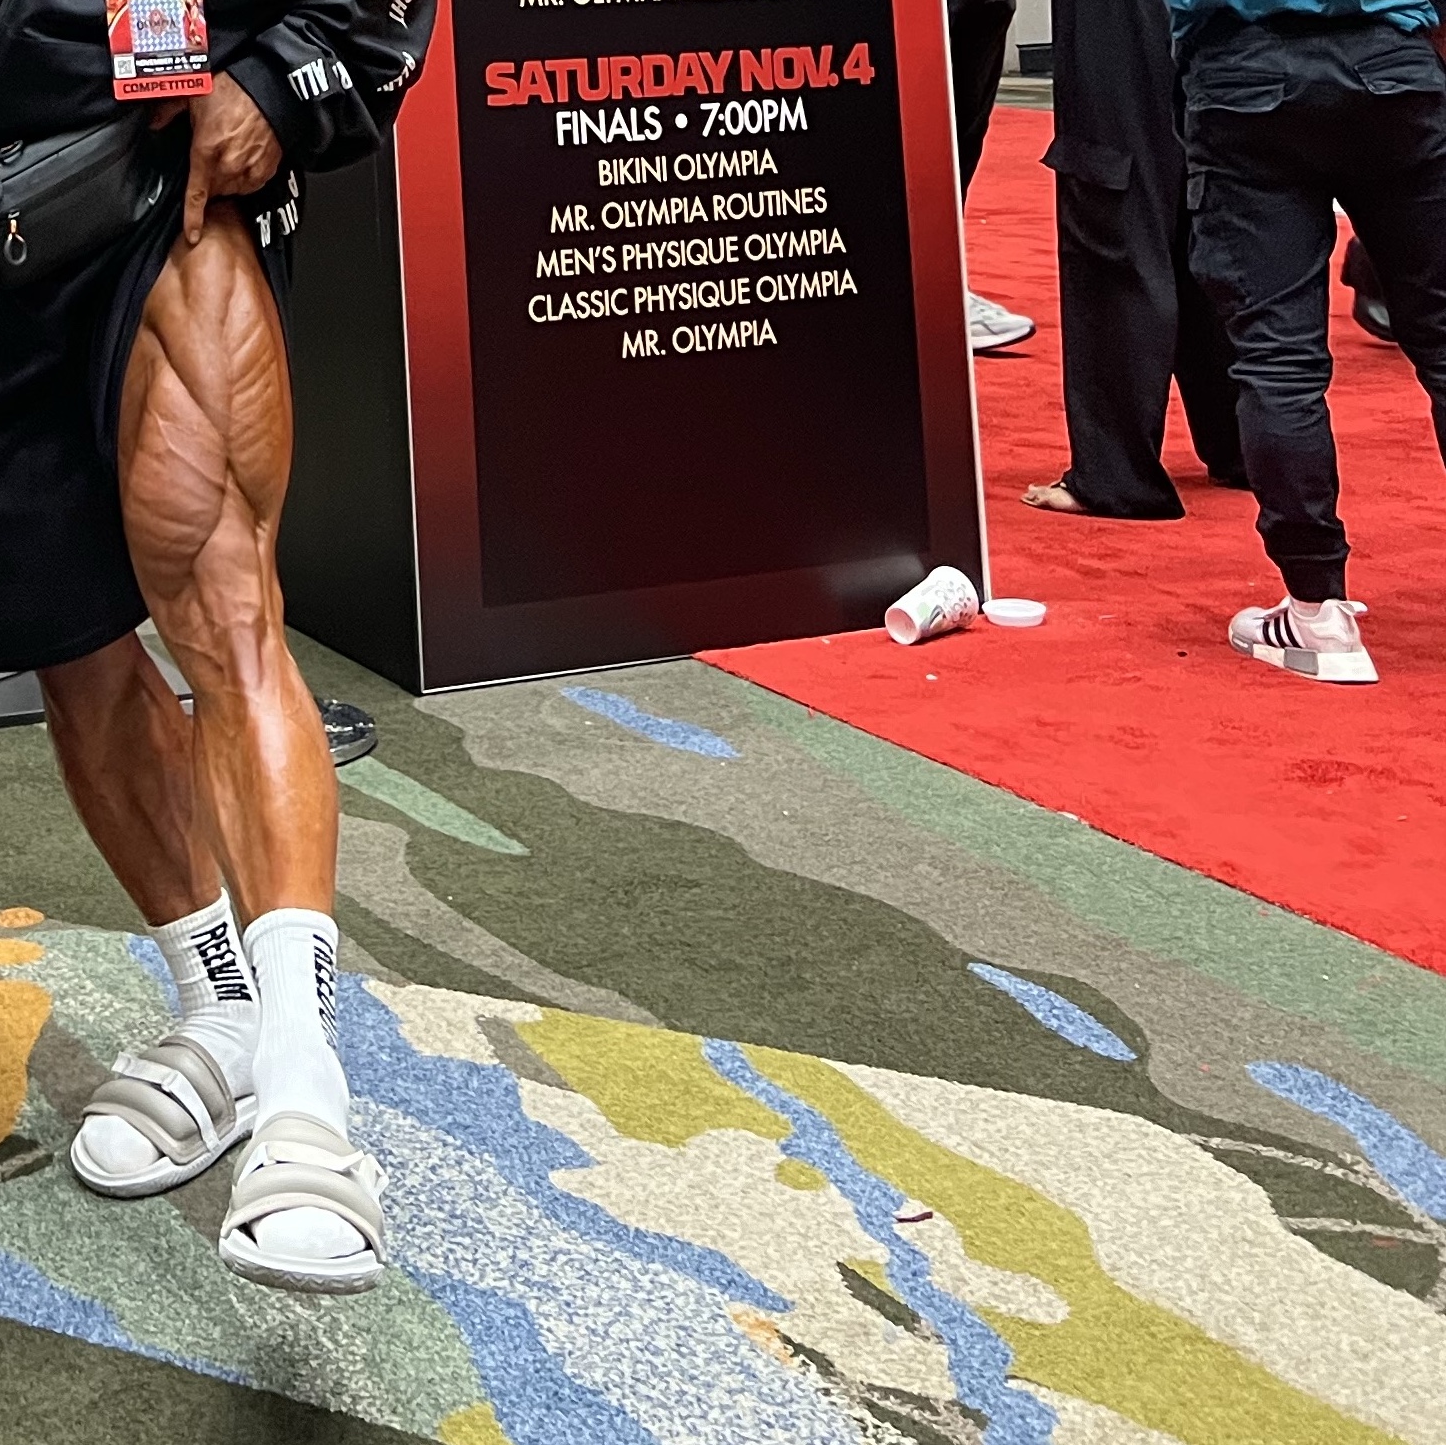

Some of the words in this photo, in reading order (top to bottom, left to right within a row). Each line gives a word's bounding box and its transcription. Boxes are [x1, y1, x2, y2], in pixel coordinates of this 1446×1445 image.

[123, 77, 204, 94] COMPETITOR
[485, 50, 734, 107] SATURDAY
[740, 45, 838, 92] NOV.
[843, 42, 875, 85] 4
[556, 106, 662, 145] FINALS
[699, 93, 807, 137] 7:00PM
[599, 156, 667, 186] BIKINI
[674, 148, 778, 181] OLYMPIA
[551, 205, 595, 233] MR.
[602, 196, 708, 229] OLYMPIA
[713, 187, 827, 221] ROUTINES
[537, 246, 616, 278] MEN'S
[623, 236, 739, 271] PHYSIQUE
[745, 228, 846, 260] OLYMPIA
[529, 288, 628, 322] CLASSIC
[634, 278, 750, 313] PHYSIQUE
[756, 269, 857, 302] OLYMPIA
[622, 330, 666, 358] MR.
[672, 319, 777, 353] OLYMPIA
